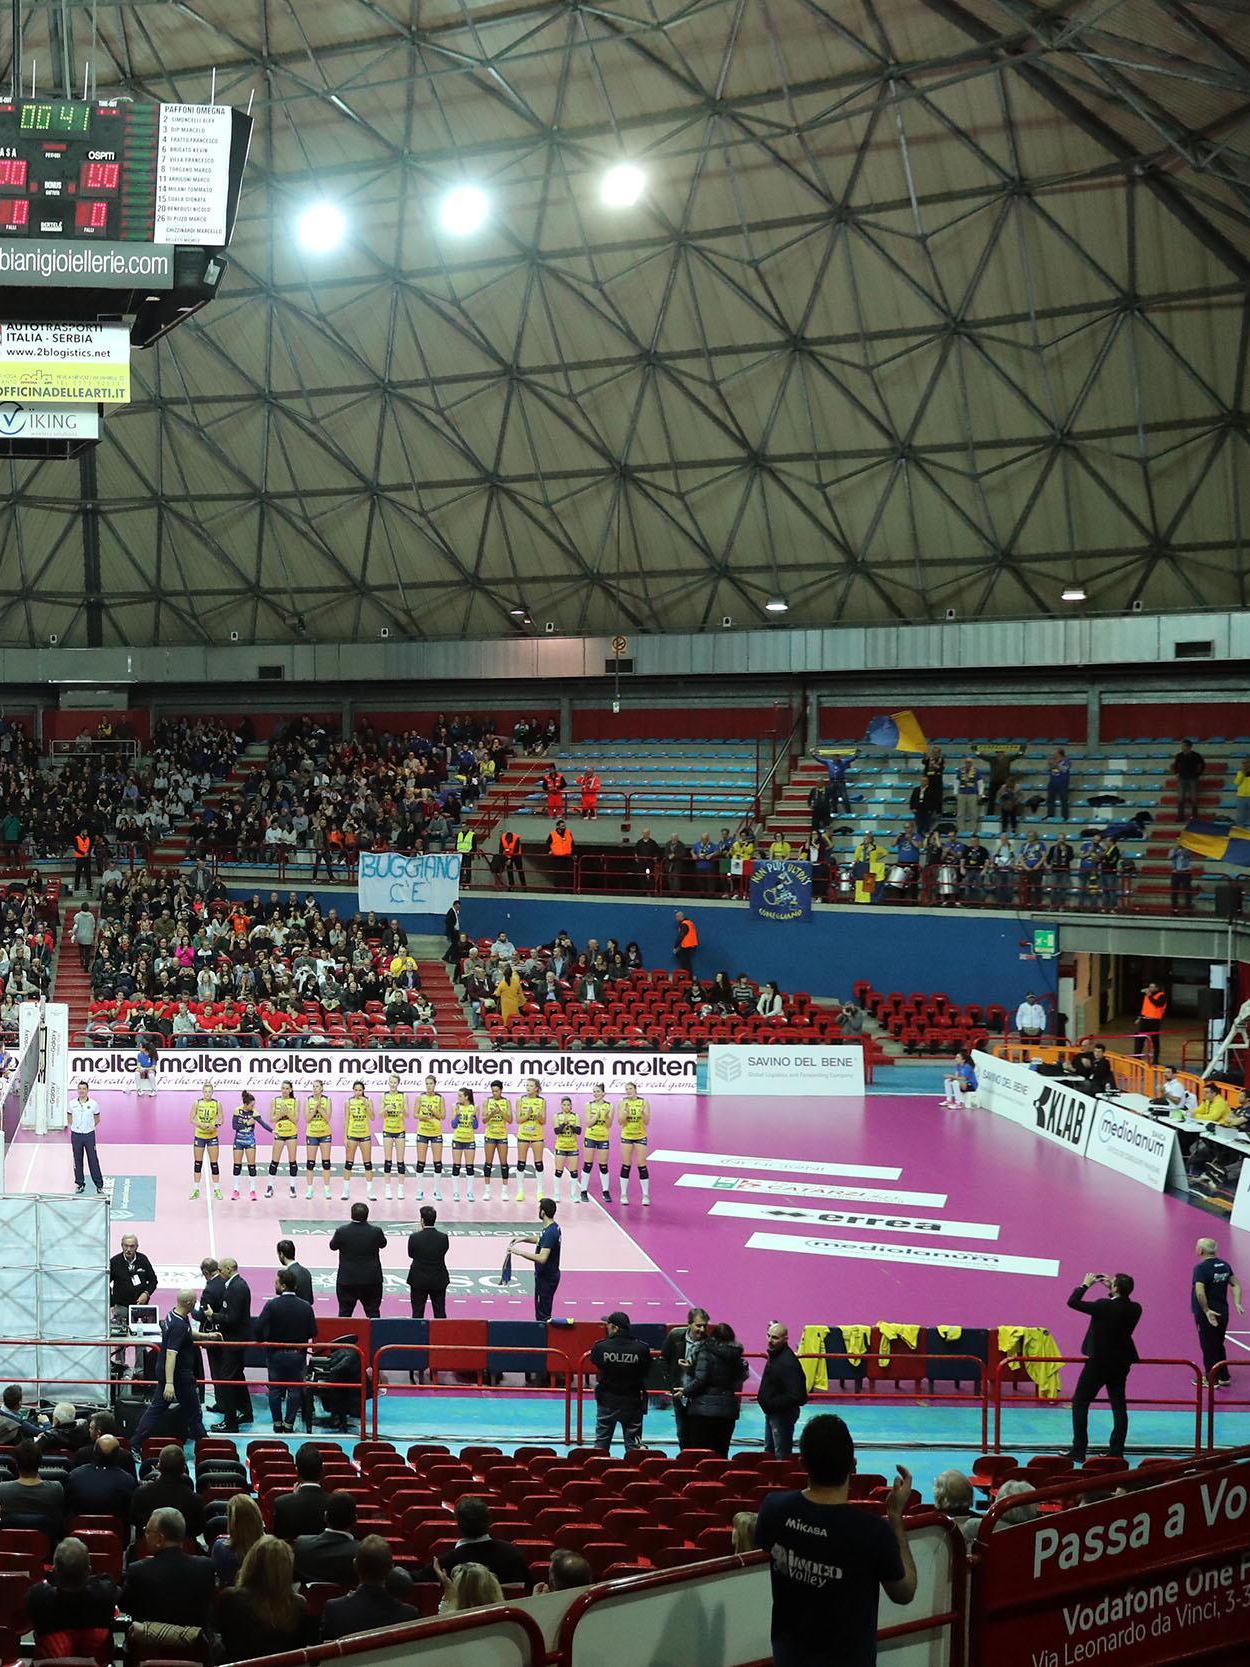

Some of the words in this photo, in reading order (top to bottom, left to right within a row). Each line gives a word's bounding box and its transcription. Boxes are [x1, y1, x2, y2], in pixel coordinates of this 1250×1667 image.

[196, 107, 225, 115] OMEGNA
[88, 151, 115, 160] OSPITI
[6, 333, 43, 342] ITALIA
[52, 333, 93, 343] SERBIA
[6, 348, 111, 359] www.2blogistics.net
[362, 854, 460, 880] BUGGIANO
[766, 861, 785, 872] PLUS
[73, 1056, 138, 1073] molte
[160, 1054, 242, 1073] molten
[250, 1055, 332, 1073] molten
[340, 1055, 422, 1074] molten
[429, 1056, 512, 1075] molten
[520, 1056, 604, 1076] molten
[612, 1057, 697, 1076] molten
[748, 1057, 790, 1066] SAVINO
[795, 1057, 816, 1066] DEL
[822, 1058, 853, 1066] BENE
[157, 1077, 172, 1086] For
[175, 1076, 190, 1085] the
[215, 1079, 242, 1088] game
[670, 1081, 697, 1091] game
[983, 1069, 1001, 1085] SAVINO
[1014, 1081, 1029, 1095] BENE
[1046, 1088, 1086, 1145] KLAB
[1101, 1117, 1164, 1157] mediolanum
[813, 1240, 1000, 1263] mediolanum
[604, 1352, 639, 1363] POLIZIA
[1033, 1513, 1151, 1579] Passa
[1164, 1503, 1185, 1538] a
[1201, 1478, 1247, 1526] Vo
[790, 1568, 827, 1588] Volley
[1063, 1580, 1178, 1636] Vodafone
[1186, 1565, 1234, 1597] One
[1032, 1651, 1059, 1667] Via
[1064, 1620, 1146, 1666] Leonardo
[1151, 1613, 1172, 1637] da
[1176, 1596, 1220, 1629] Vinci,
